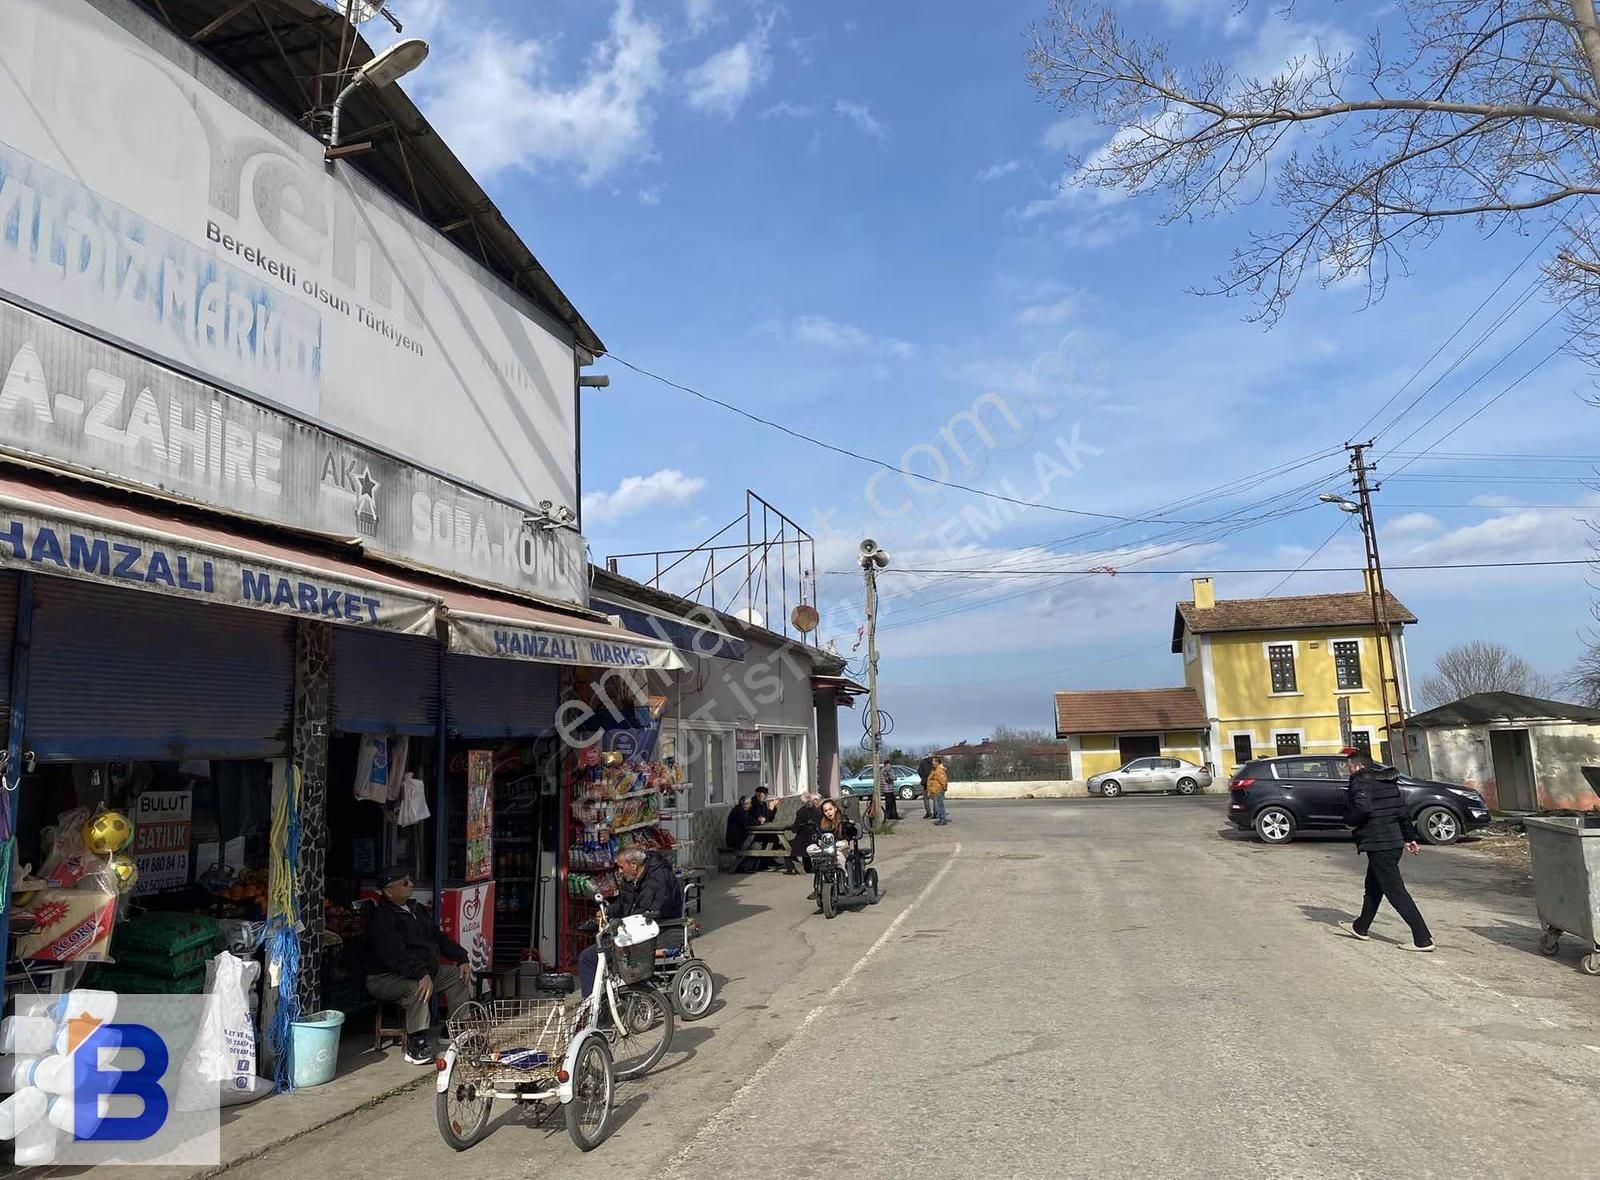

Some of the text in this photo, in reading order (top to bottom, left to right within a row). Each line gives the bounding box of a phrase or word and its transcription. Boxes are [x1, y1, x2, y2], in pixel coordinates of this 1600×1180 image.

[205, 218, 424, 357] Bereketli olsun Türkiyem
[320, 451, 357, 493] AK
[0, 520, 381, 624] HAMZALI MARKET
[494, 629, 650, 666] HAMZALI MARKET
[140, 795, 189, 813] BULUT
